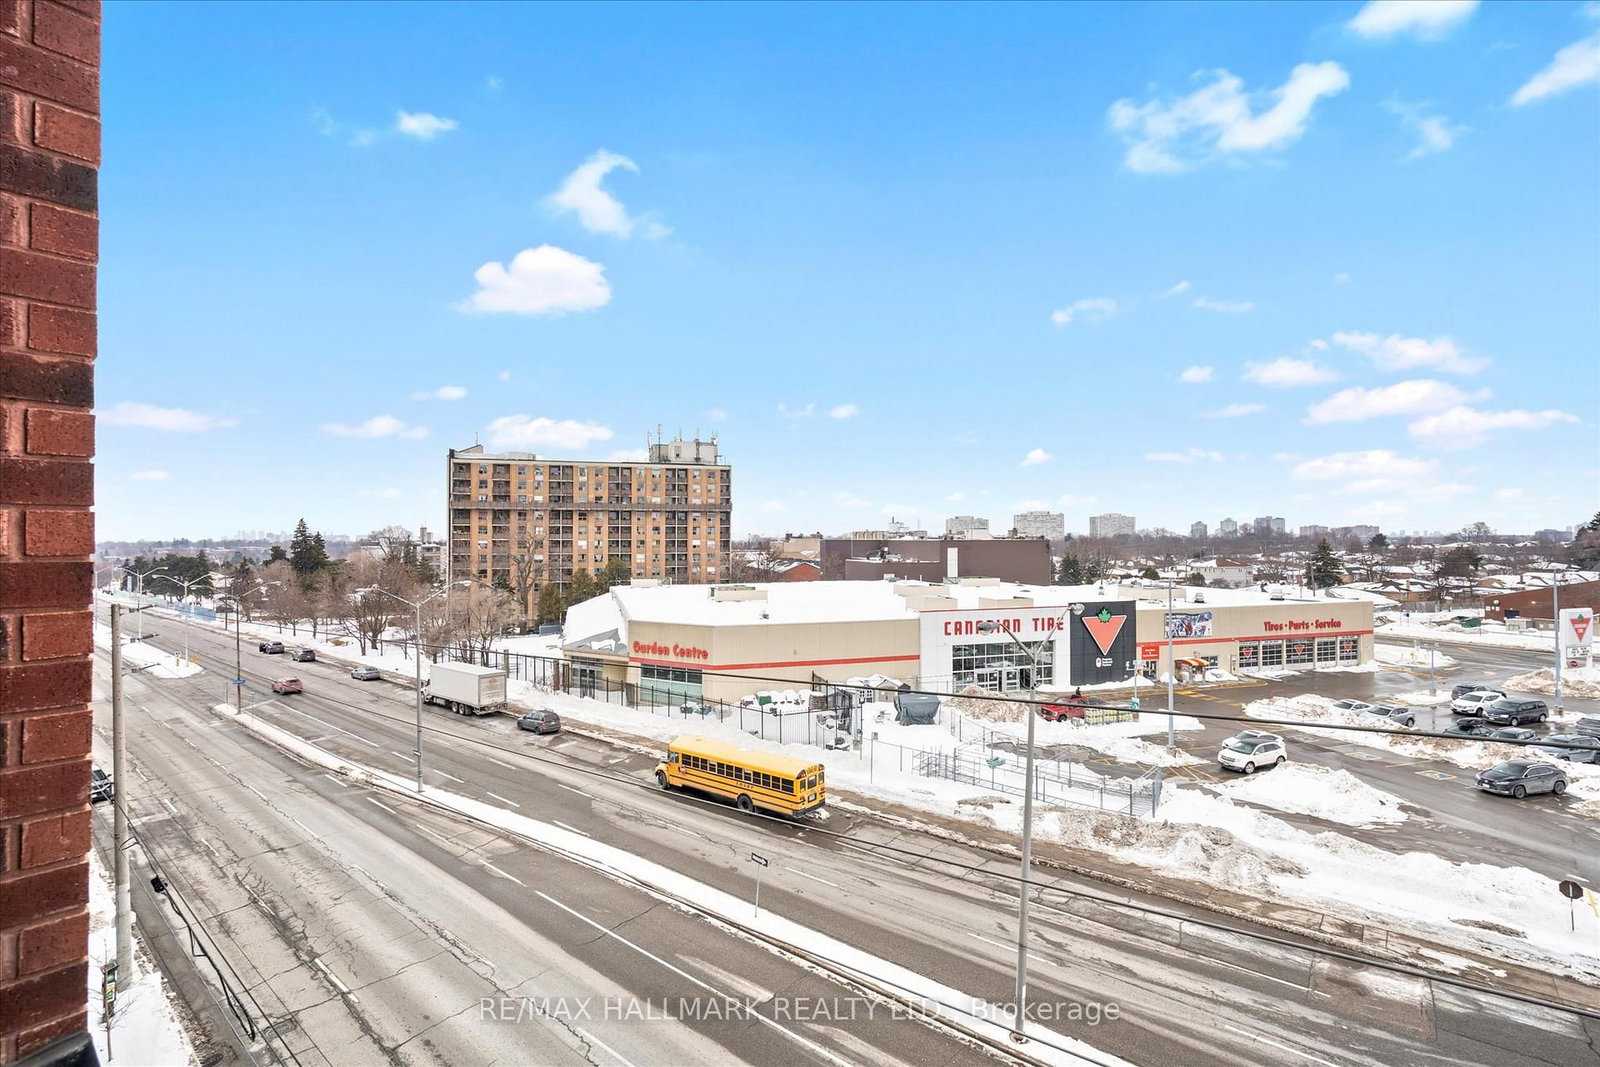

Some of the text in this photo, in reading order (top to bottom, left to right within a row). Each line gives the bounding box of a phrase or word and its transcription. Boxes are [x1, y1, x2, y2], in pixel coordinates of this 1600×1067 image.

[944, 616, 1064, 636] CANAIAN TIRE
[1263, 618, 1342, 632] Tires Parts Service
[633, 640, 709, 659] Garden Centre
